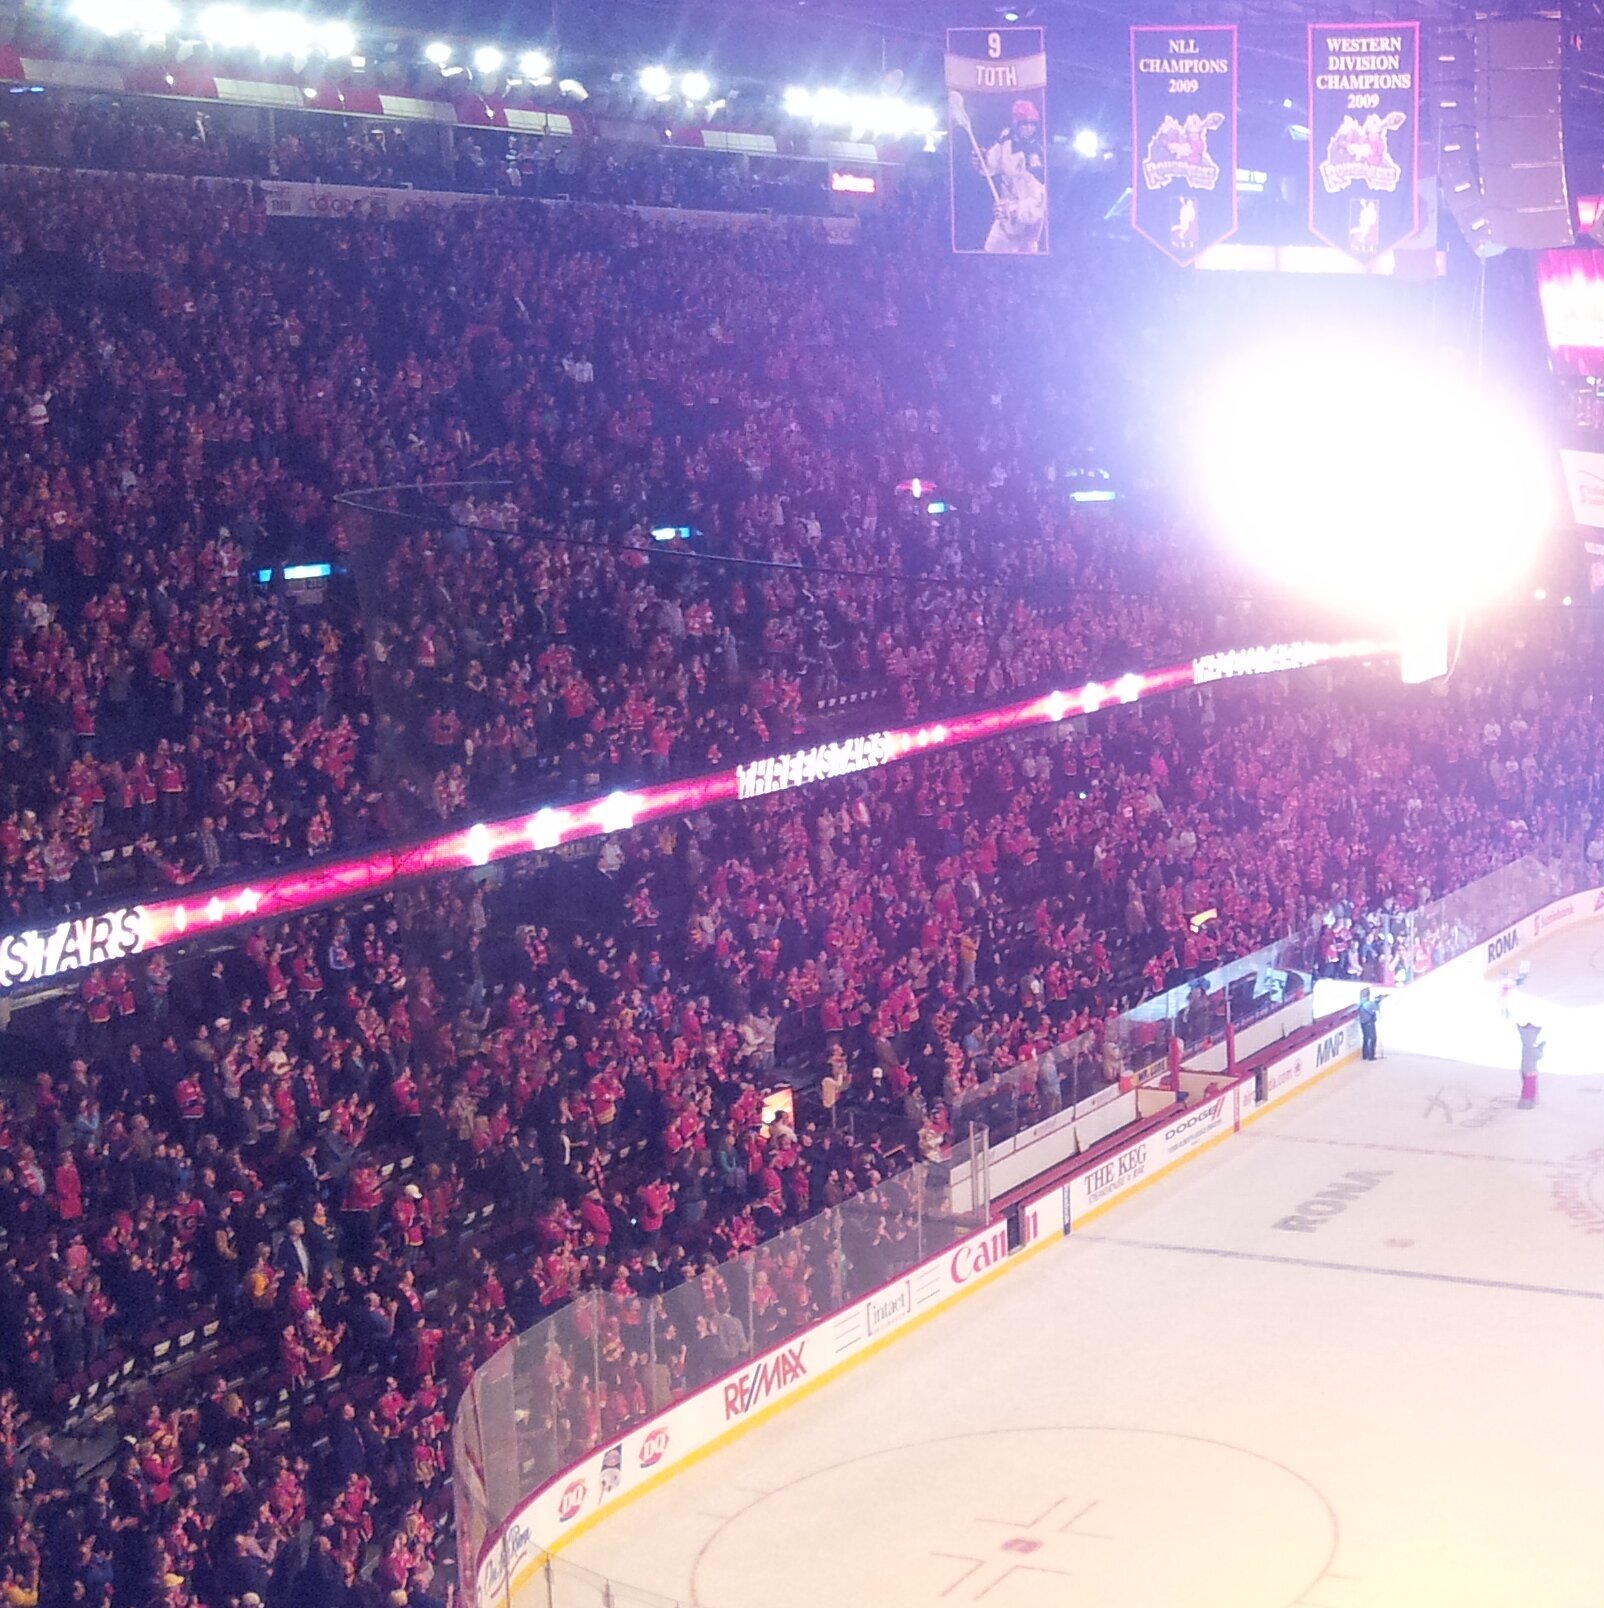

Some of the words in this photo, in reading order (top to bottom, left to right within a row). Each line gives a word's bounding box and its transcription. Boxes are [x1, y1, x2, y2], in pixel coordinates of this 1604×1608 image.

[988, 32, 1001, 58] 9
[1168, 39, 1199, 53] NLL
[1326, 37, 1402, 52] WESTERN
[1139, 59, 1228, 73] CHAMPIONS
[1328, 55, 1400, 70] DIVISION
[976, 65, 1017, 86] TOTH
[1168, 79, 1199, 93] 2009
[1316, 73, 1412, 89] CHAMPIONS
[1347, 94, 1380, 108] 2009
[0, 906, 144, 986] STARS
[1487, 929, 1519, 963] RONA
[1316, 1031, 1344, 1068] MNP
[1165, 1104, 1218, 1140] DODGE
[1084, 1161, 1114, 1196] THE
[1117, 1143, 1147, 1177] KEG
[1270, 1169, 1394, 1233] RONA
[723, 1341, 808, 1421] RE/MAX
